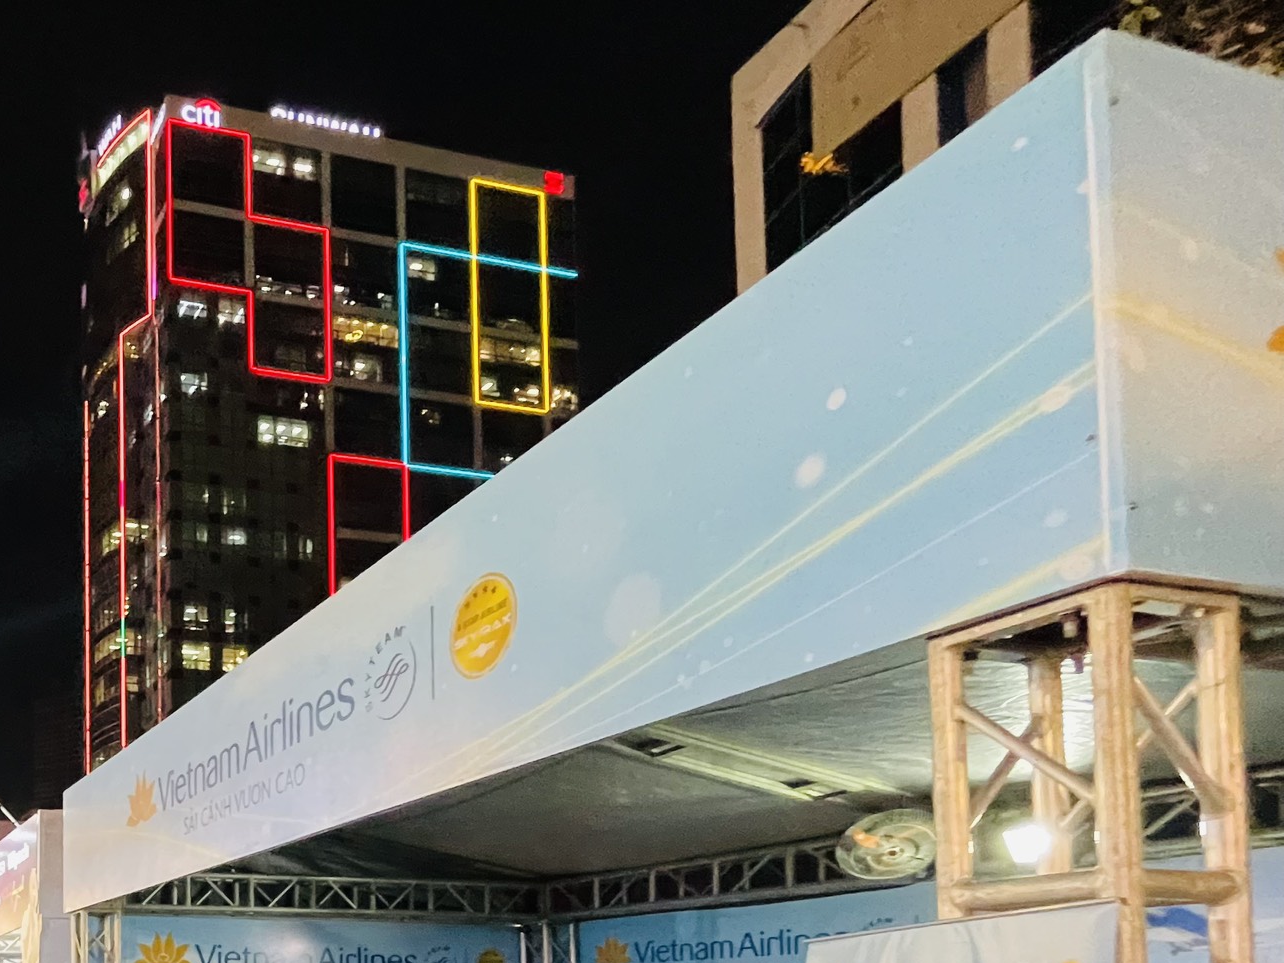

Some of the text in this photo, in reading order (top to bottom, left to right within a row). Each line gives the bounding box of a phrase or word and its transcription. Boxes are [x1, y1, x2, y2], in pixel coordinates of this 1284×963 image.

[158, 677, 356, 811] Vietnam Airlines
[275, 763, 306, 794] CAO
[634, 928, 850, 963] Vietnam Airlin
